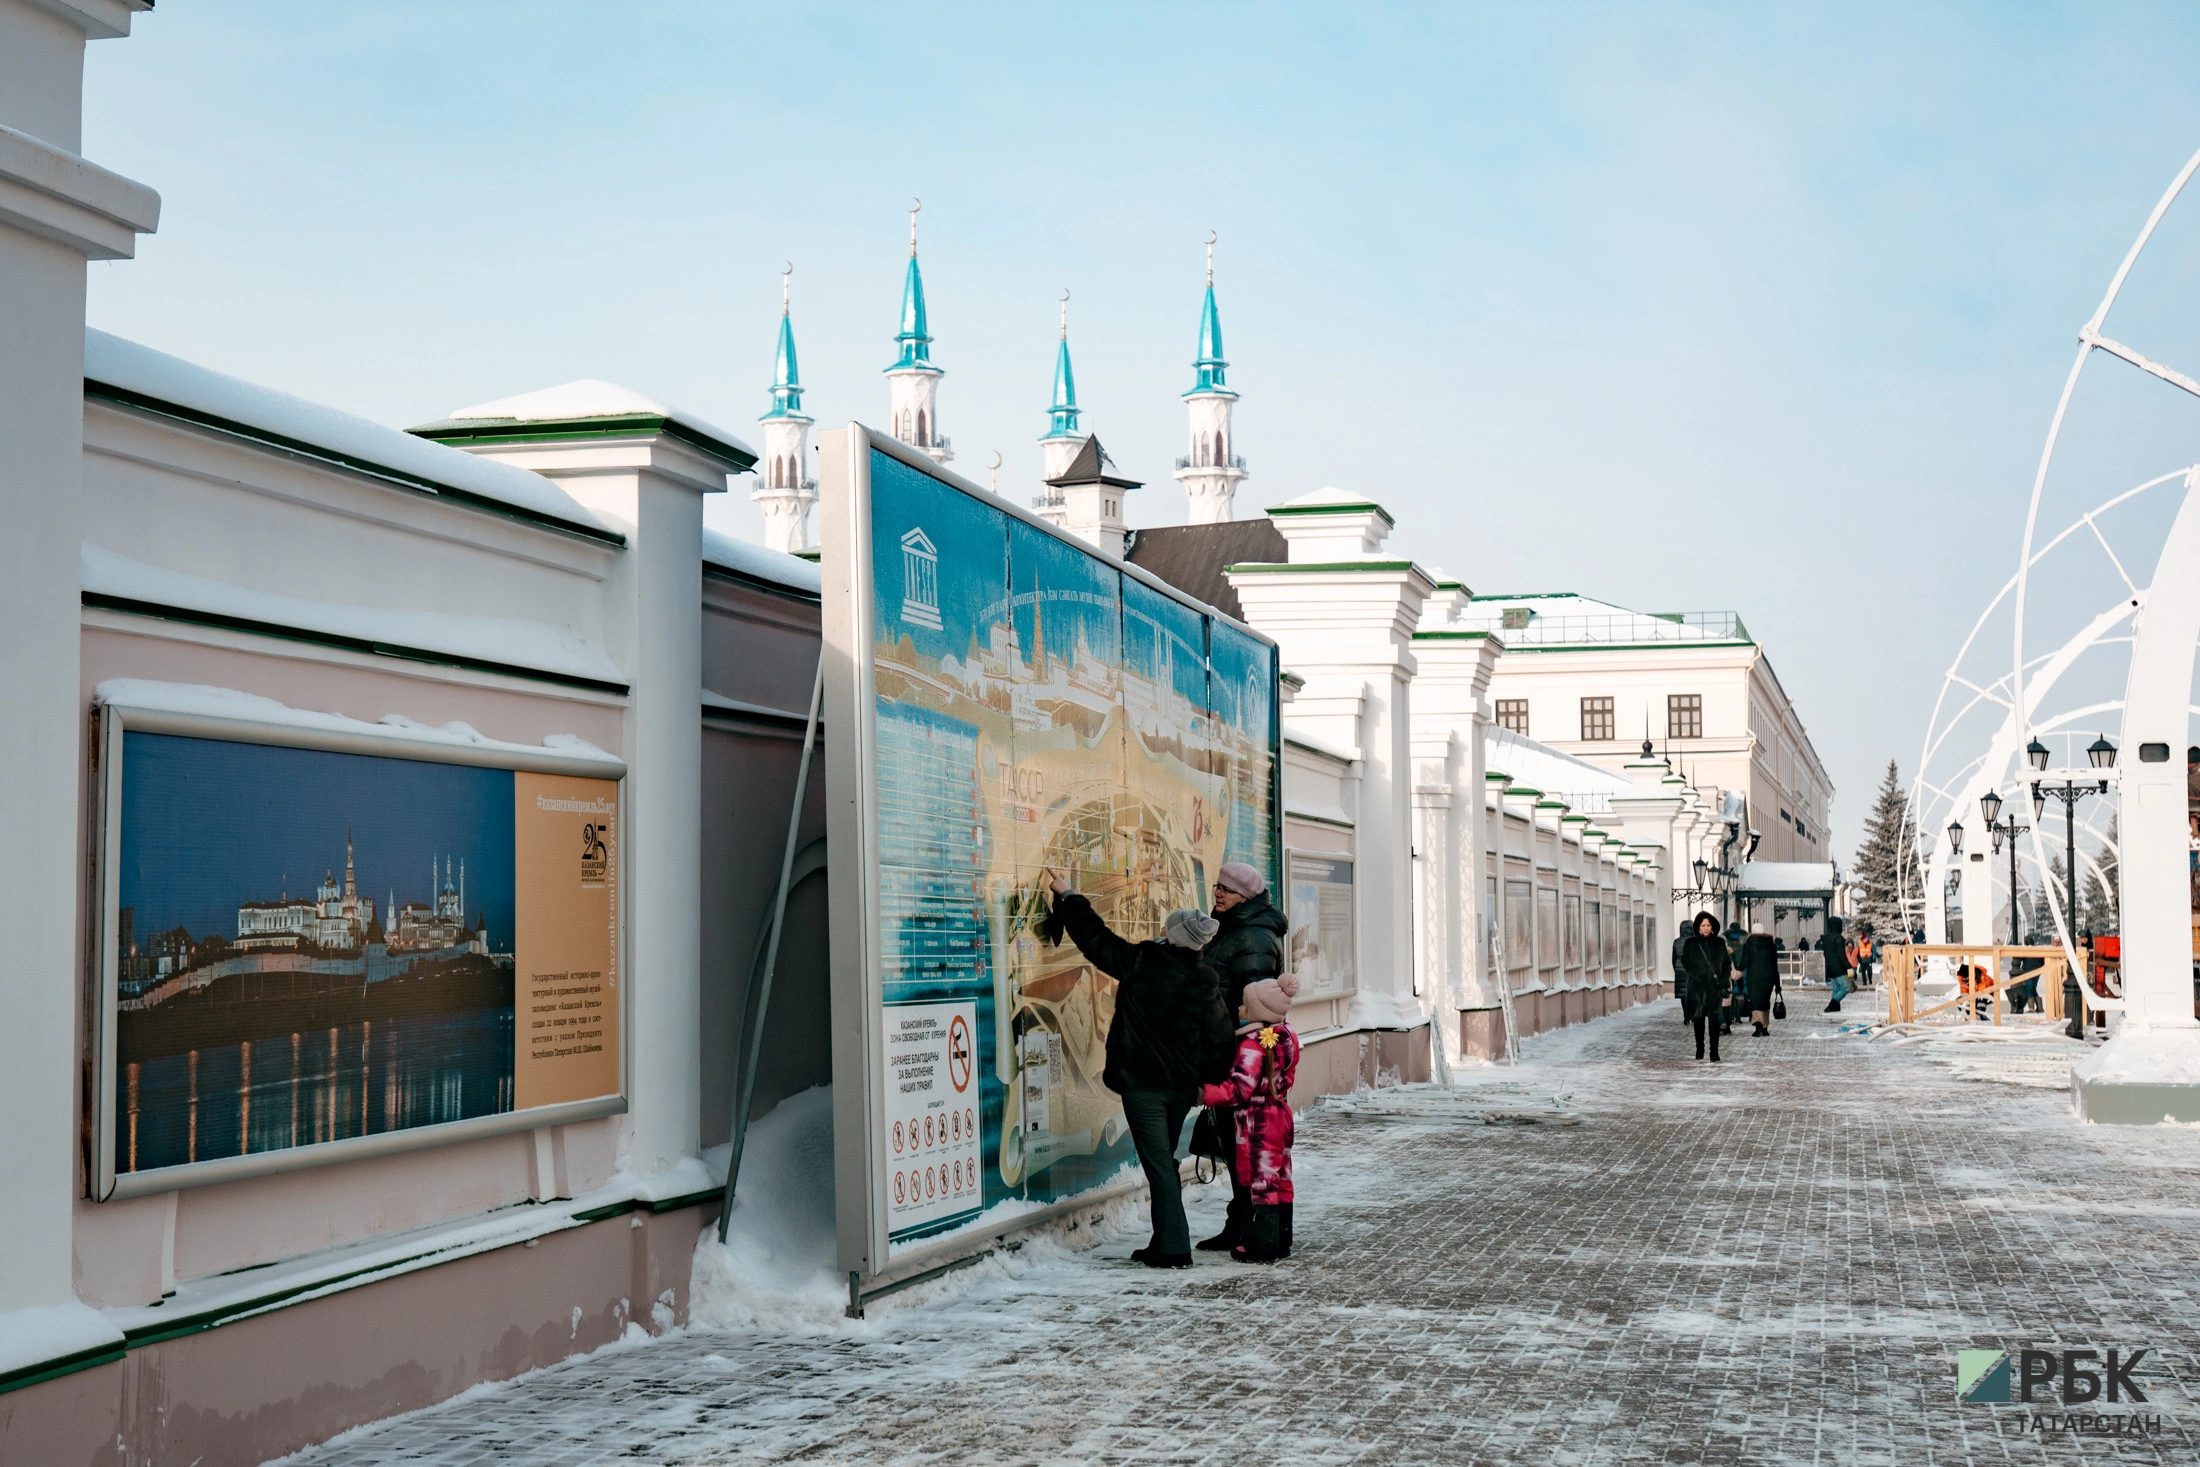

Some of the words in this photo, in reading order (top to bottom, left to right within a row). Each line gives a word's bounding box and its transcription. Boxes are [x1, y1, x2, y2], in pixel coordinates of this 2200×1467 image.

[890, 1034, 901, 1043] ЗОНА
[902, 1031, 925, 1042] СВОБОДНАЯ
[925, 1031, 930, 1040] ОТ
[890, 1054, 911, 1066] ЗАРАНЕЕ
[911, 1052, 939, 1064] БЛАГОДАРНЫ
[898, 1069, 904, 1080] ЗА
[904, 1066, 934, 1079] ВЫПОЛНЕНИЕ
[900, 1081, 916, 1093] НАШИХ
[916, 1080, 933, 1092] ПРАВИЛ
